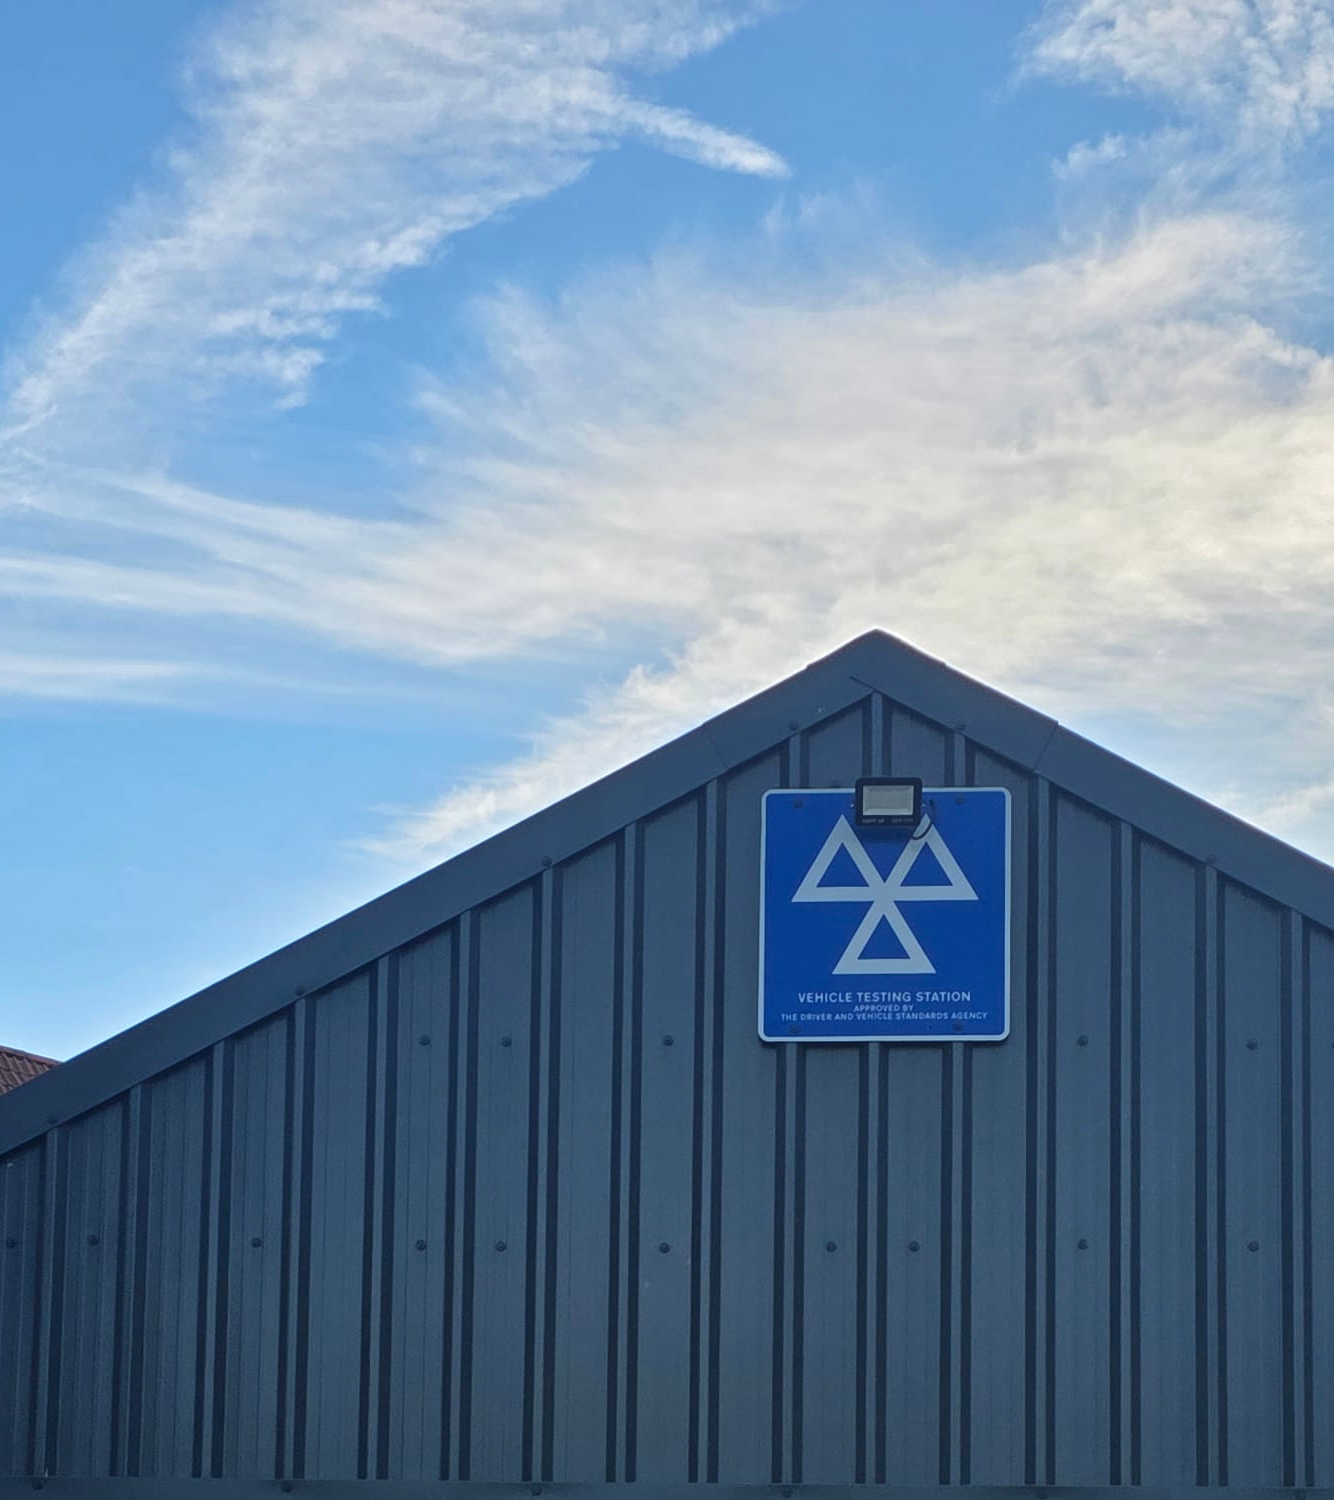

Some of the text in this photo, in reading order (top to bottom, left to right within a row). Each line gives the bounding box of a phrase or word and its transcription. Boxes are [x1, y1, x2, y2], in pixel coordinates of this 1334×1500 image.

[798, 991, 971, 1003] VEHICLE TESTING STATION
[853, 1004, 915, 1012] APPROVED BY
[781, 1012, 988, 1021] THE DRIVER AND VEHICLE STANDARDS AGENCY
